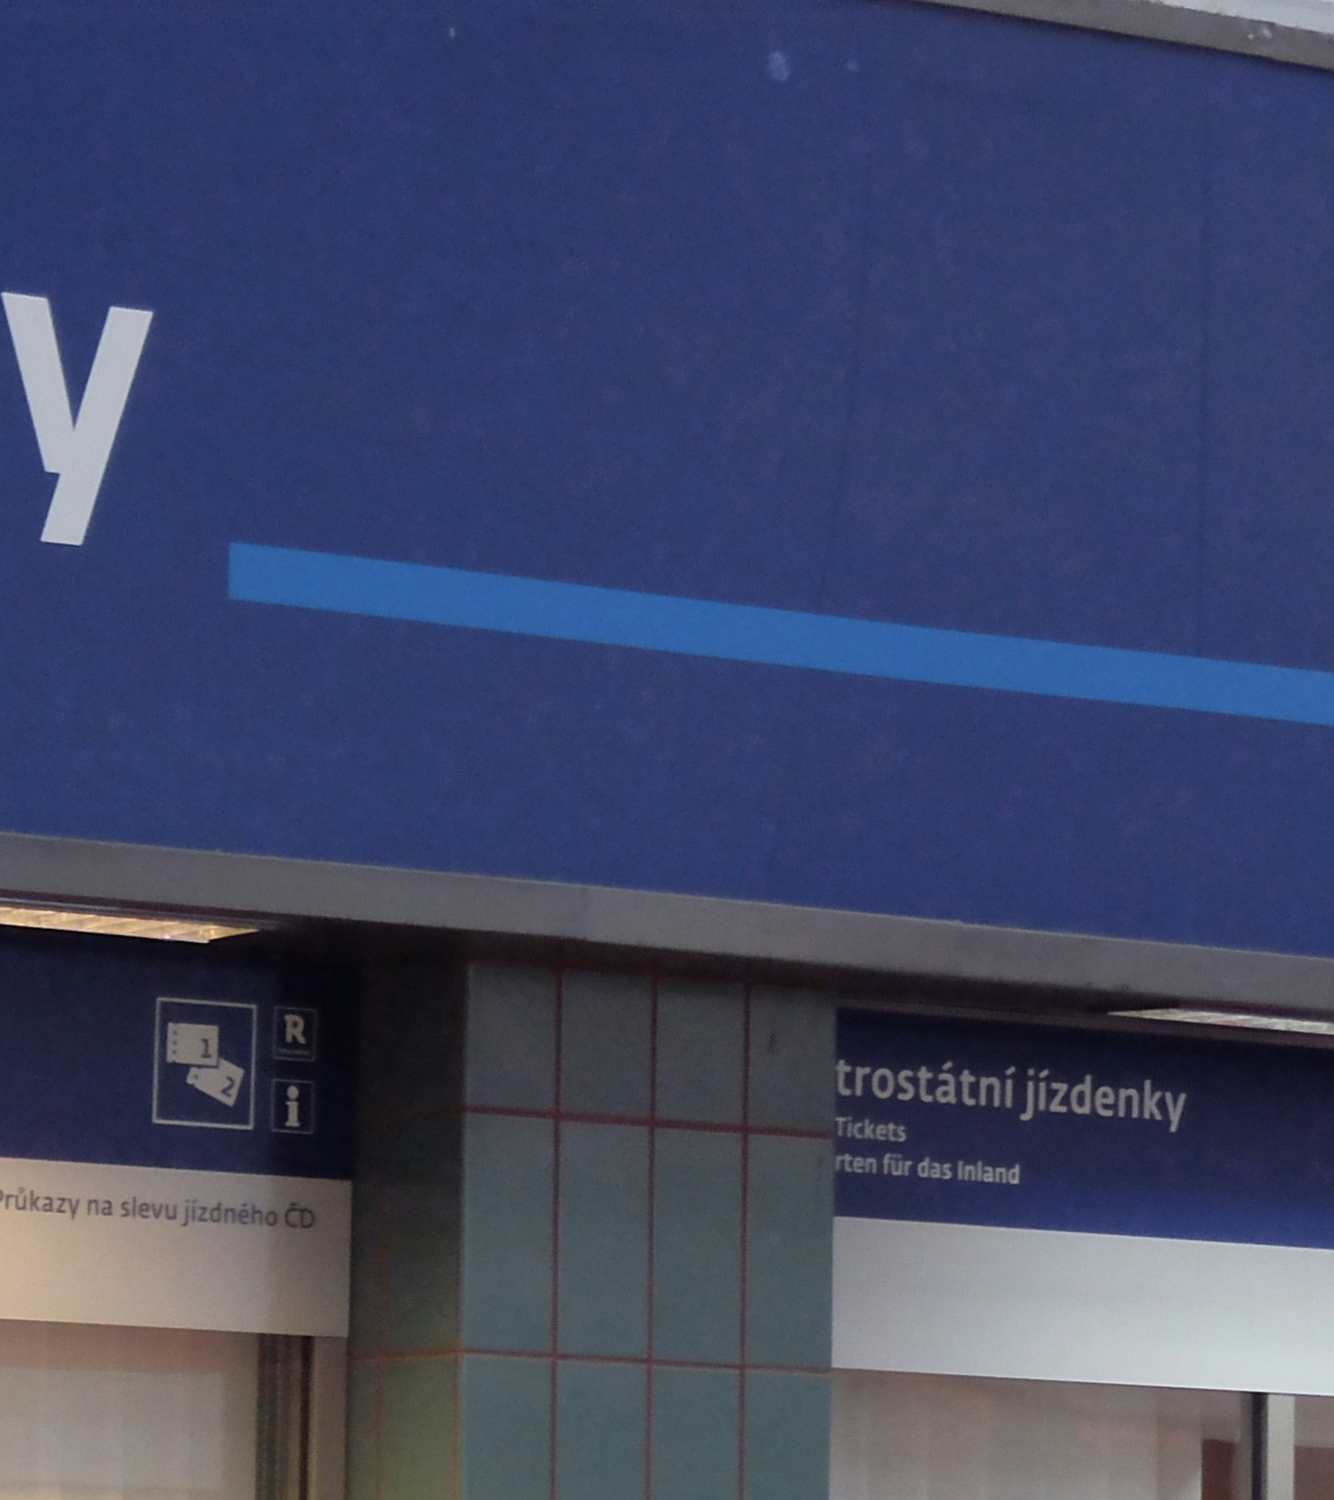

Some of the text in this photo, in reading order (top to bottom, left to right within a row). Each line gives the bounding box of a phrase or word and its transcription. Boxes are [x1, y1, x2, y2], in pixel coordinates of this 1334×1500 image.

[283, 1013, 307, 1045] R
[834, 1059, 1187, 1133] trostátní jízdenky
[833, 1116, 907, 1143] Tickets
[834, 1153, 1020, 1185] rten für das Inland
[87, 1198, 114, 1217] na
[120, 1196, 179, 1221] slevu
[182, 1197, 281, 1230] jízdného
[284, 1202, 317, 1229] ČD
